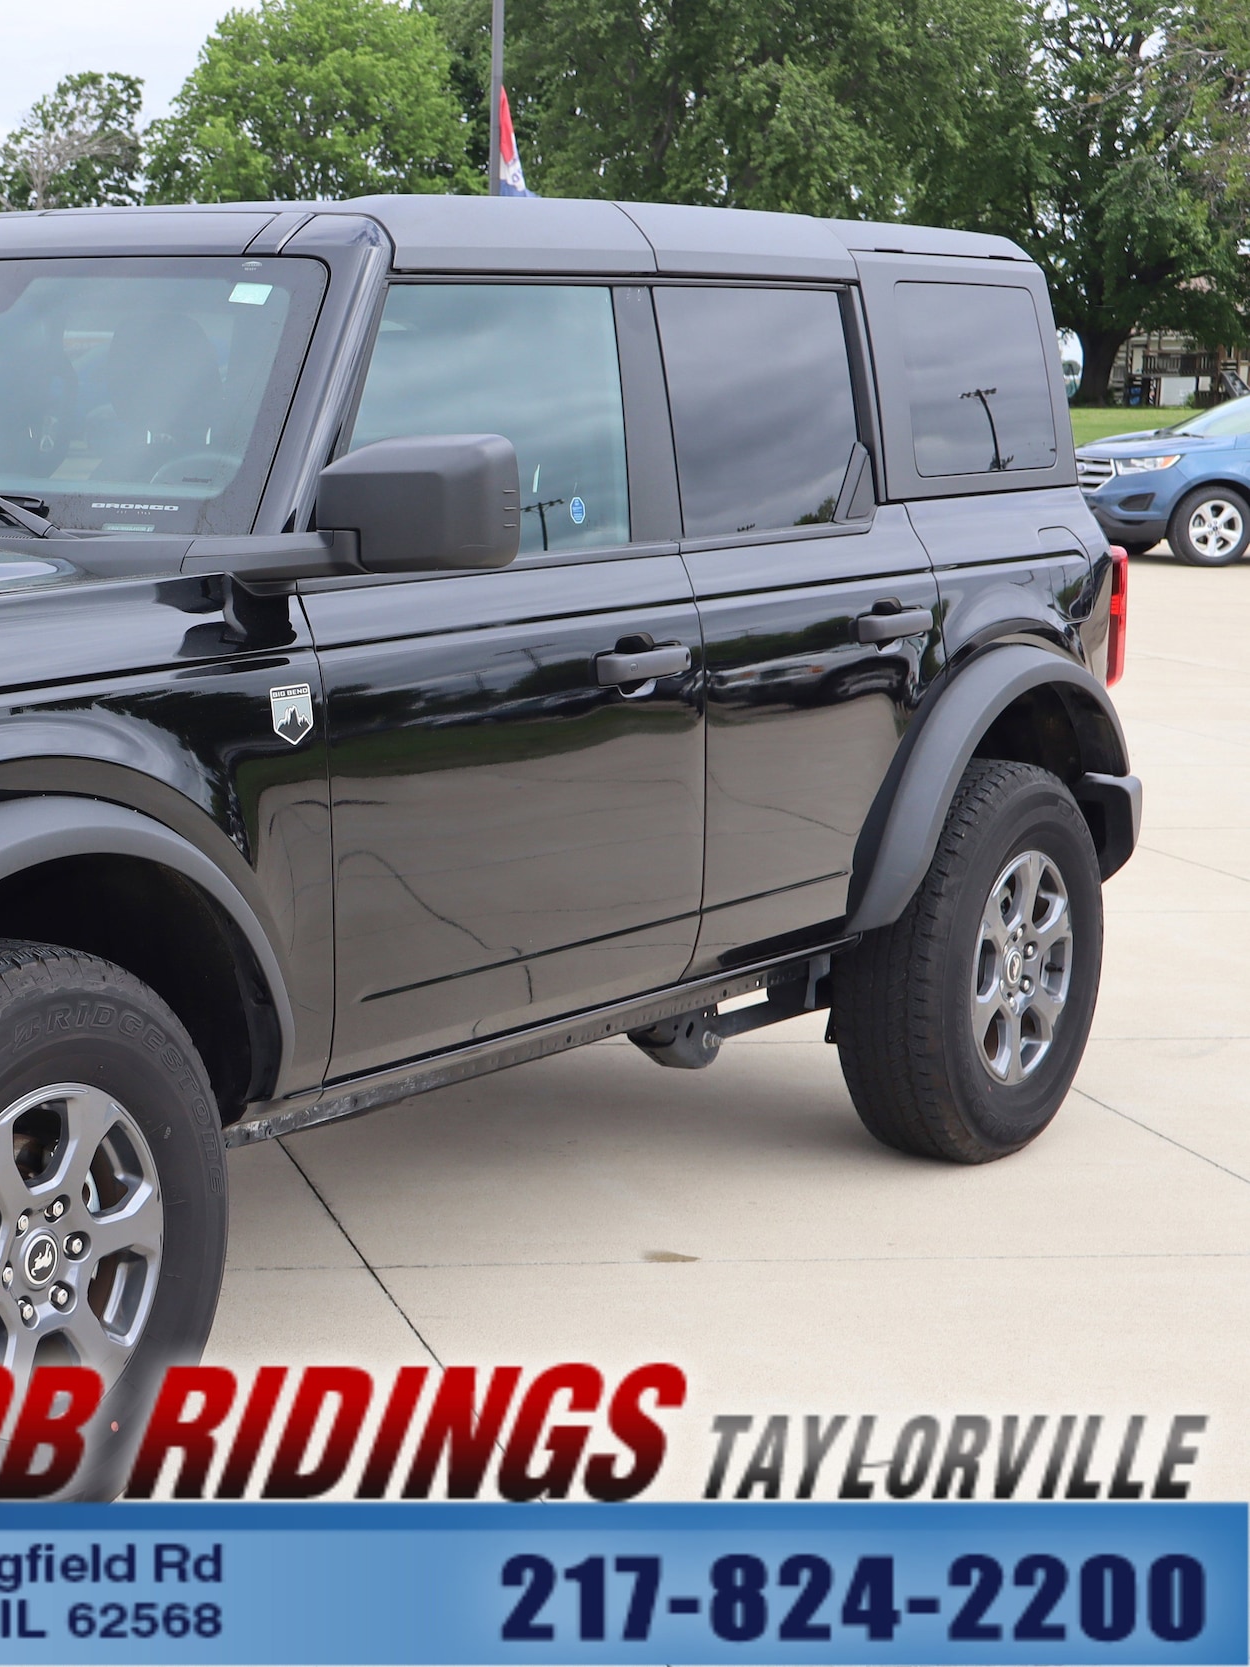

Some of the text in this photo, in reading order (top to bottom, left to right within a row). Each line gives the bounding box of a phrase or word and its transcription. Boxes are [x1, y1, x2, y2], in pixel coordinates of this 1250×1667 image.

[91, 502, 179, 512] BRONCO
[287, 687, 308, 696] BEND
[12, 1002, 224, 1195] BRIDGESTONE
